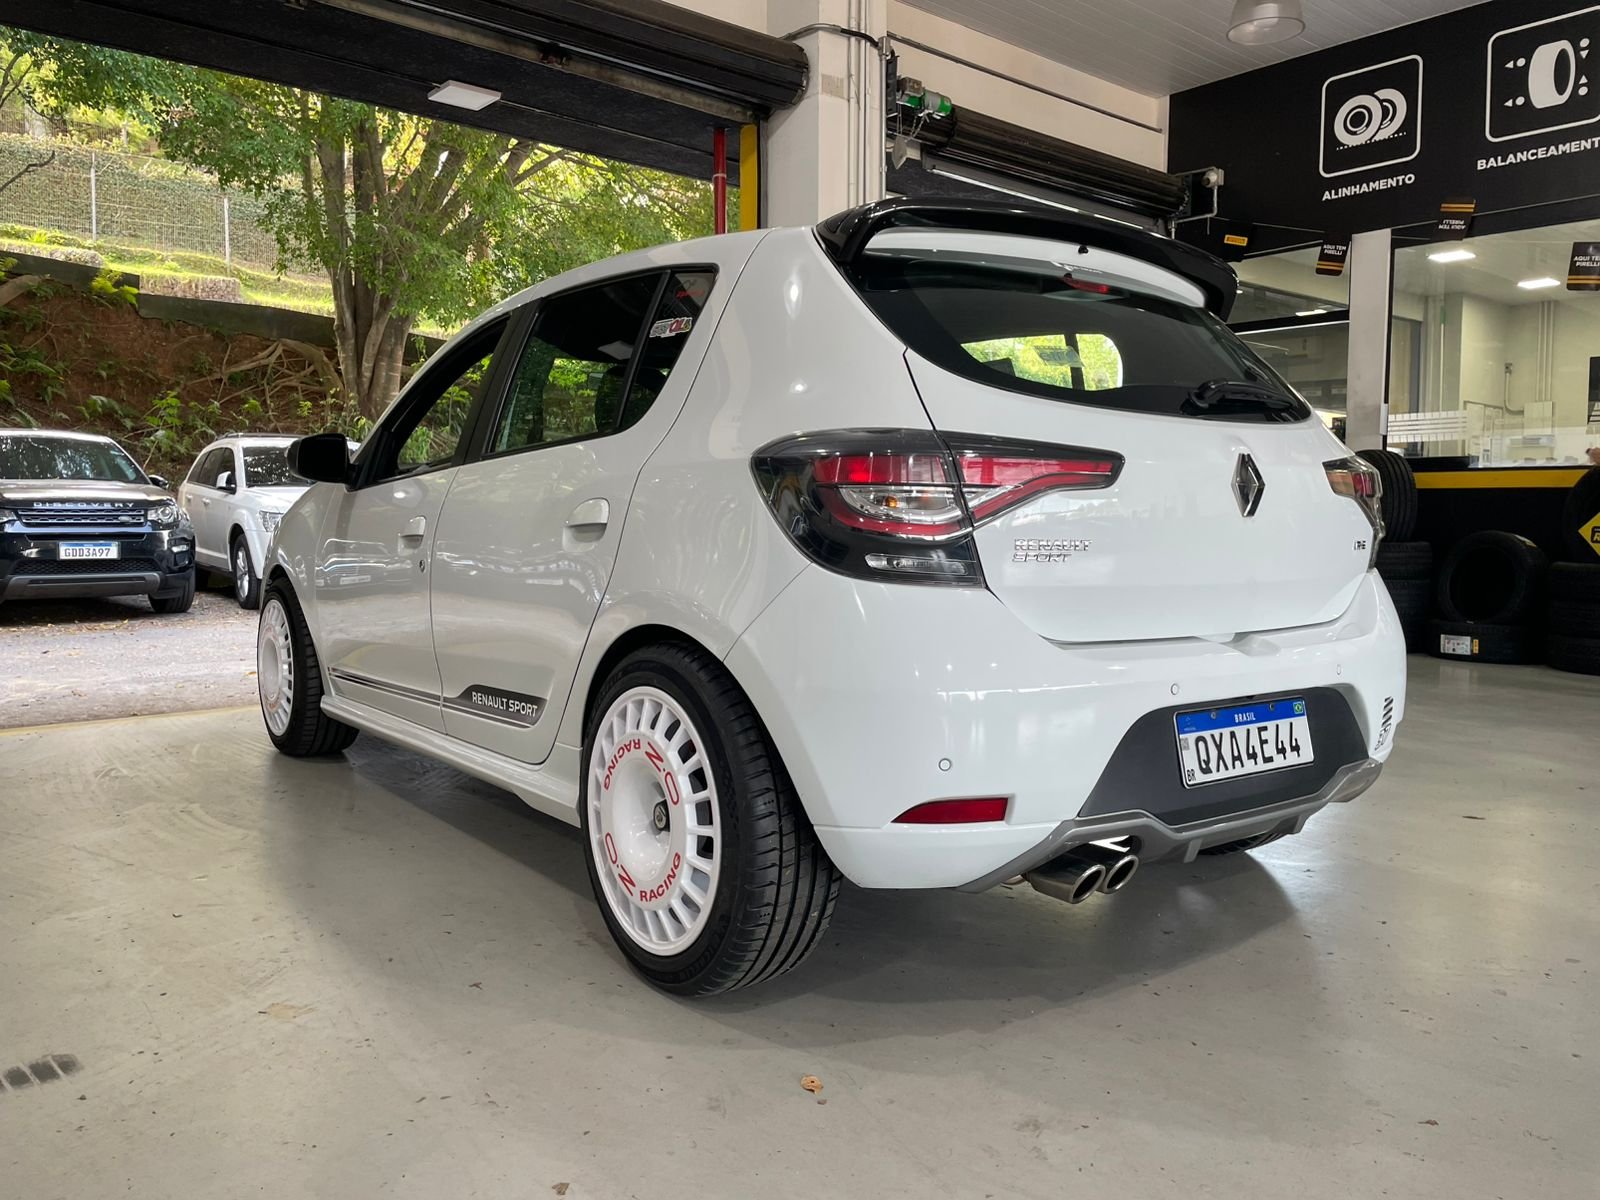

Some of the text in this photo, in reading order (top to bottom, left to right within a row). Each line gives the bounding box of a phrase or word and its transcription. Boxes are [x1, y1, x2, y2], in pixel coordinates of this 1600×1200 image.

[1321, 173, 1416, 202] ALINHAMENTO
[64, 547, 111, 558] GDD3A97
[1013, 538, 1092, 552] RENAULT
[1011, 551, 1072, 563] SPORT
[471, 691, 538, 718] RENAULT SPORT
[1234, 711, 1256, 723] BRASIL
[1194, 721, 1301, 775] QXA4E44
[603, 738, 641, 791] RACING
[1186, 768, 1197, 782] BR
[639, 851, 681, 902] RACING
